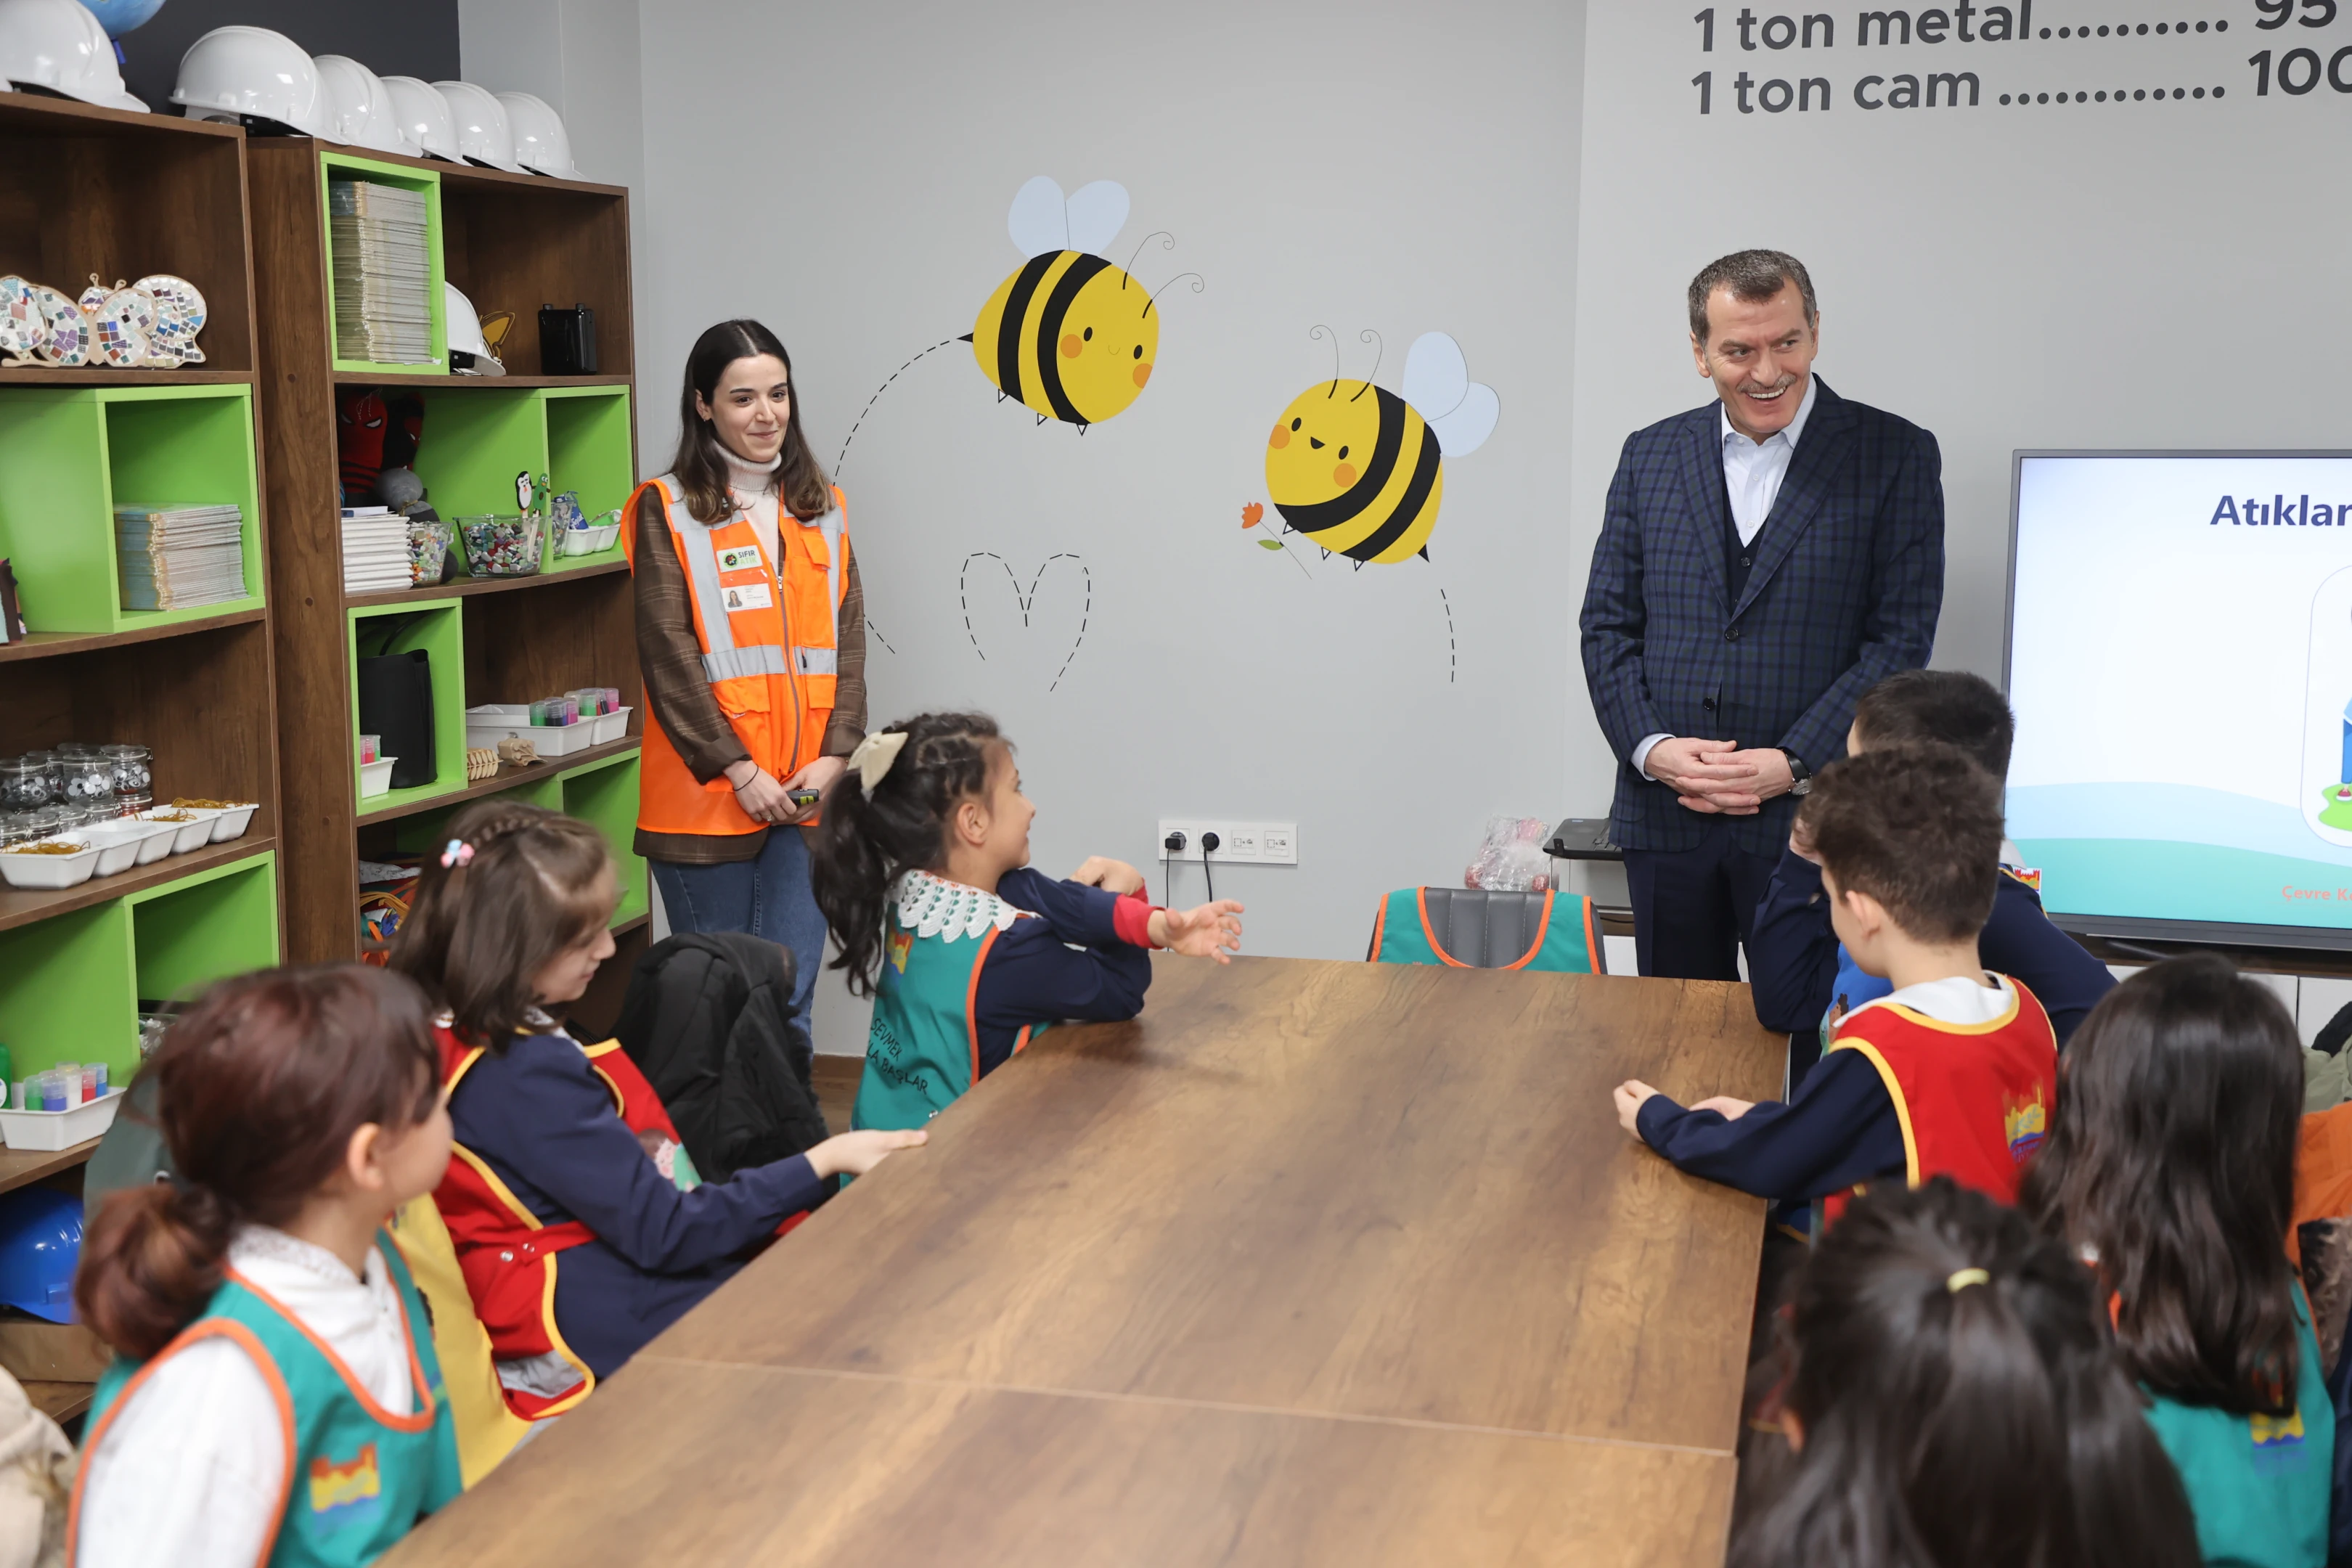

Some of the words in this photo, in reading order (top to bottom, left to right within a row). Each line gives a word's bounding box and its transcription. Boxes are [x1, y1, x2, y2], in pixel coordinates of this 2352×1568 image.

[1694, 8, 1714, 52] 1
[1736, 8, 1834, 51] ton
[2255, 0, 2337, 30] 95
[1691, 71, 1712, 115] 1
[1734, 72, 1831, 114] ton
[1853, 72, 1980, 110] cam
[2210, 494, 2352, 527] Atıklar
[2282, 885, 2331, 902] Çevre
[870, 1018, 902, 1062] SEVMEK
[881, 1058, 928, 1095] BAŞLAR
